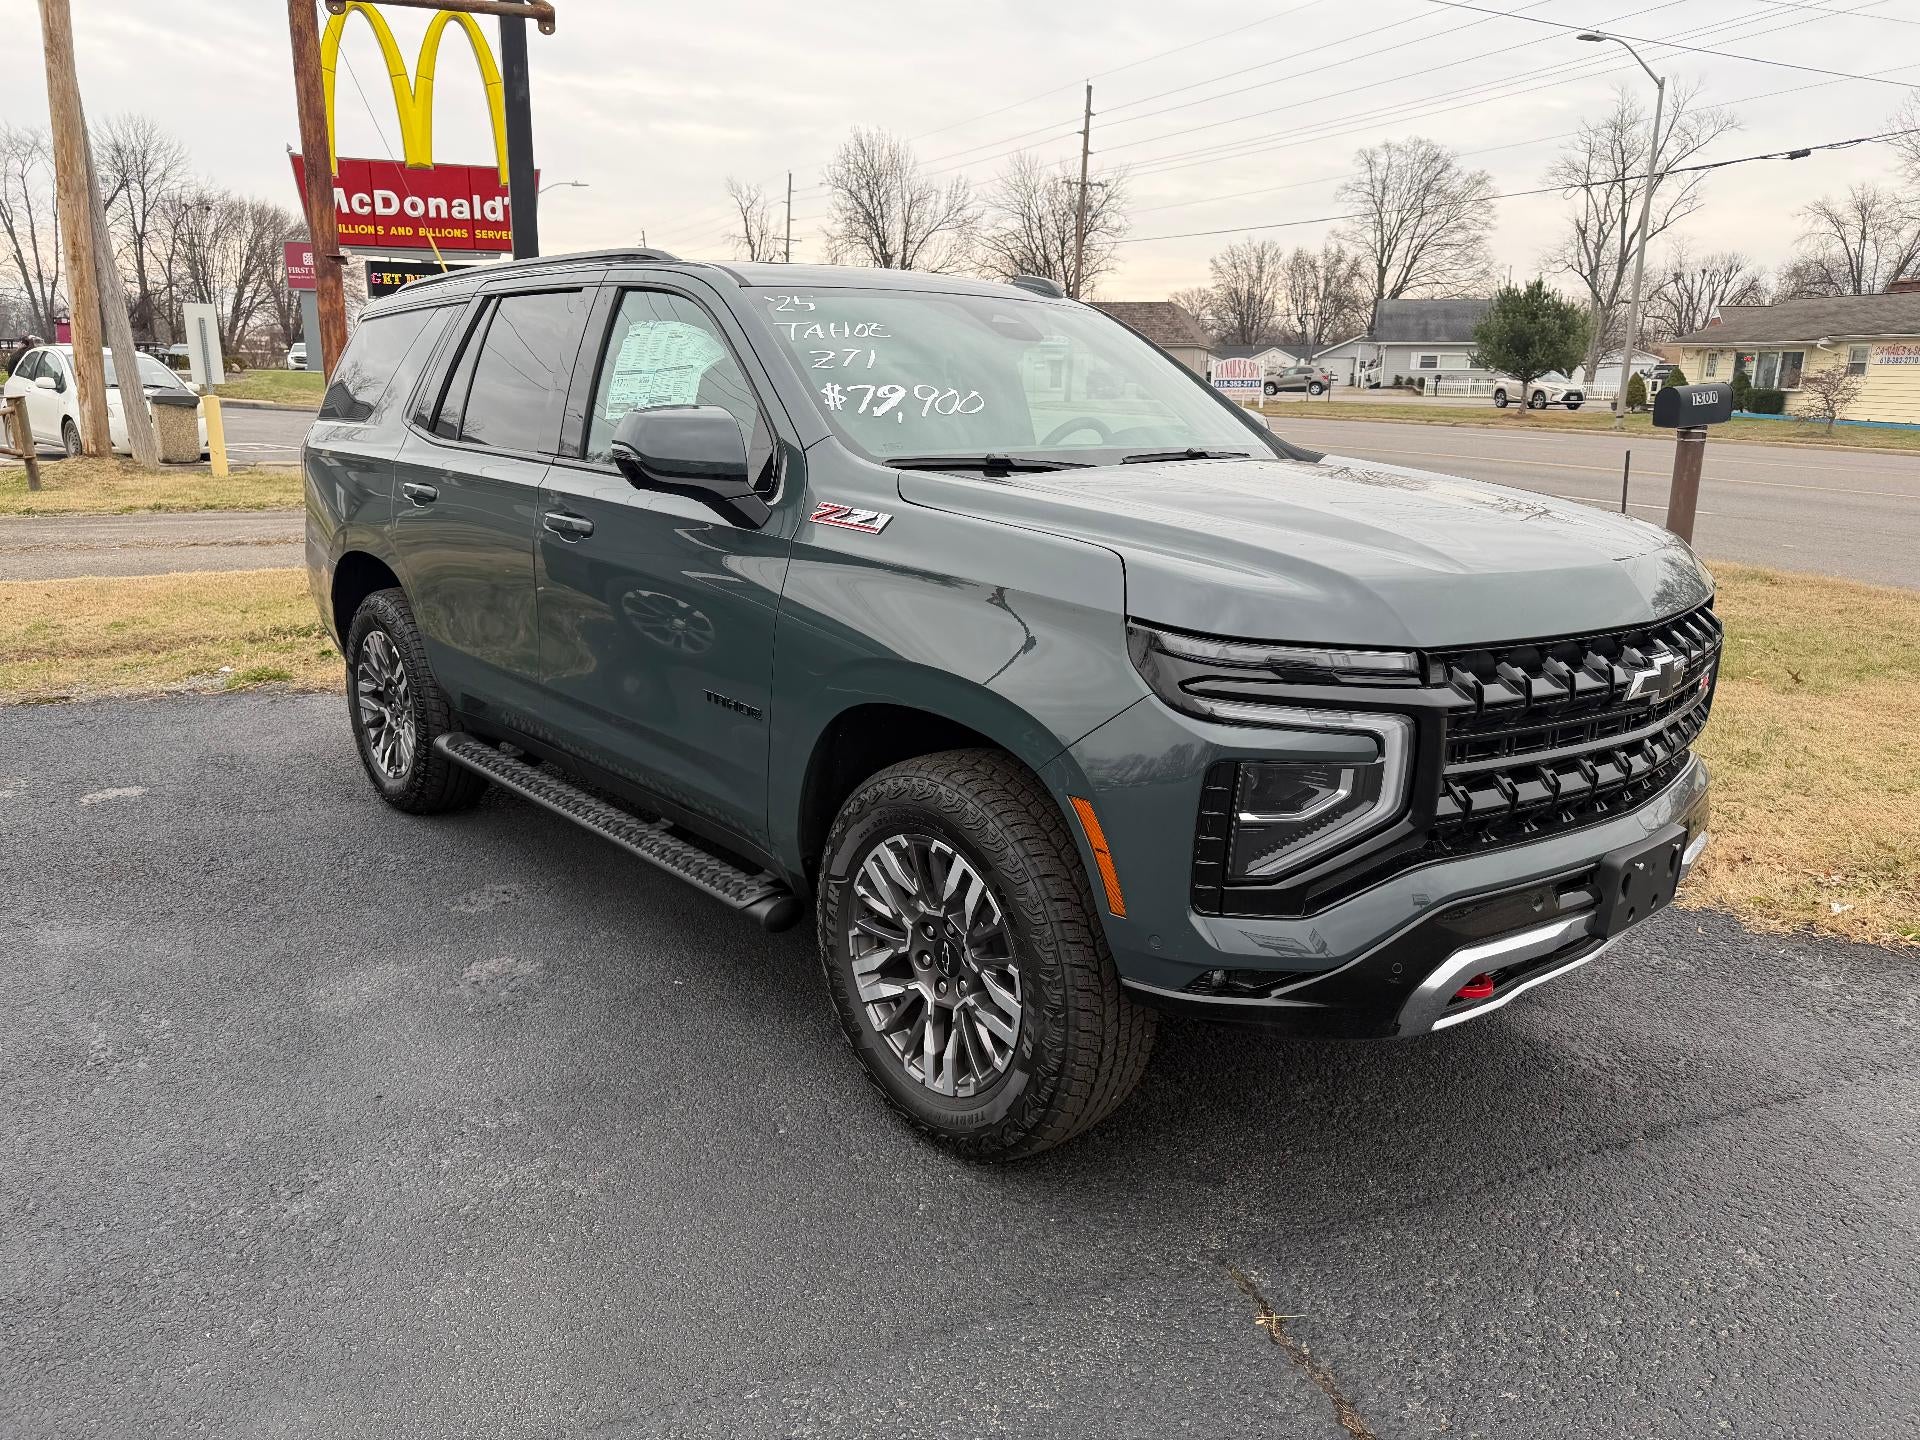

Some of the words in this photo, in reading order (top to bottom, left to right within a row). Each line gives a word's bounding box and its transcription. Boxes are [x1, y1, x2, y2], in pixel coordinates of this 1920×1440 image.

[333, 187, 509, 222] McDonald'
[337, 224, 384, 235] ILLIONS
[390, 227, 413, 236] AND
[418, 228, 468, 238] BILLIONS
[287, 266, 310, 274] FIRST
[371, 272, 401, 285] GET
[773, 322, 892, 341] TAHOE
[1214, 380, 1260, 388] 618-382-2710
[821, 382, 985, 424] $79,900
[1693, 391, 1718, 405] 1300
[809, 501, 894, 535] Z71
[702, 688, 763, 721] TAHOE
